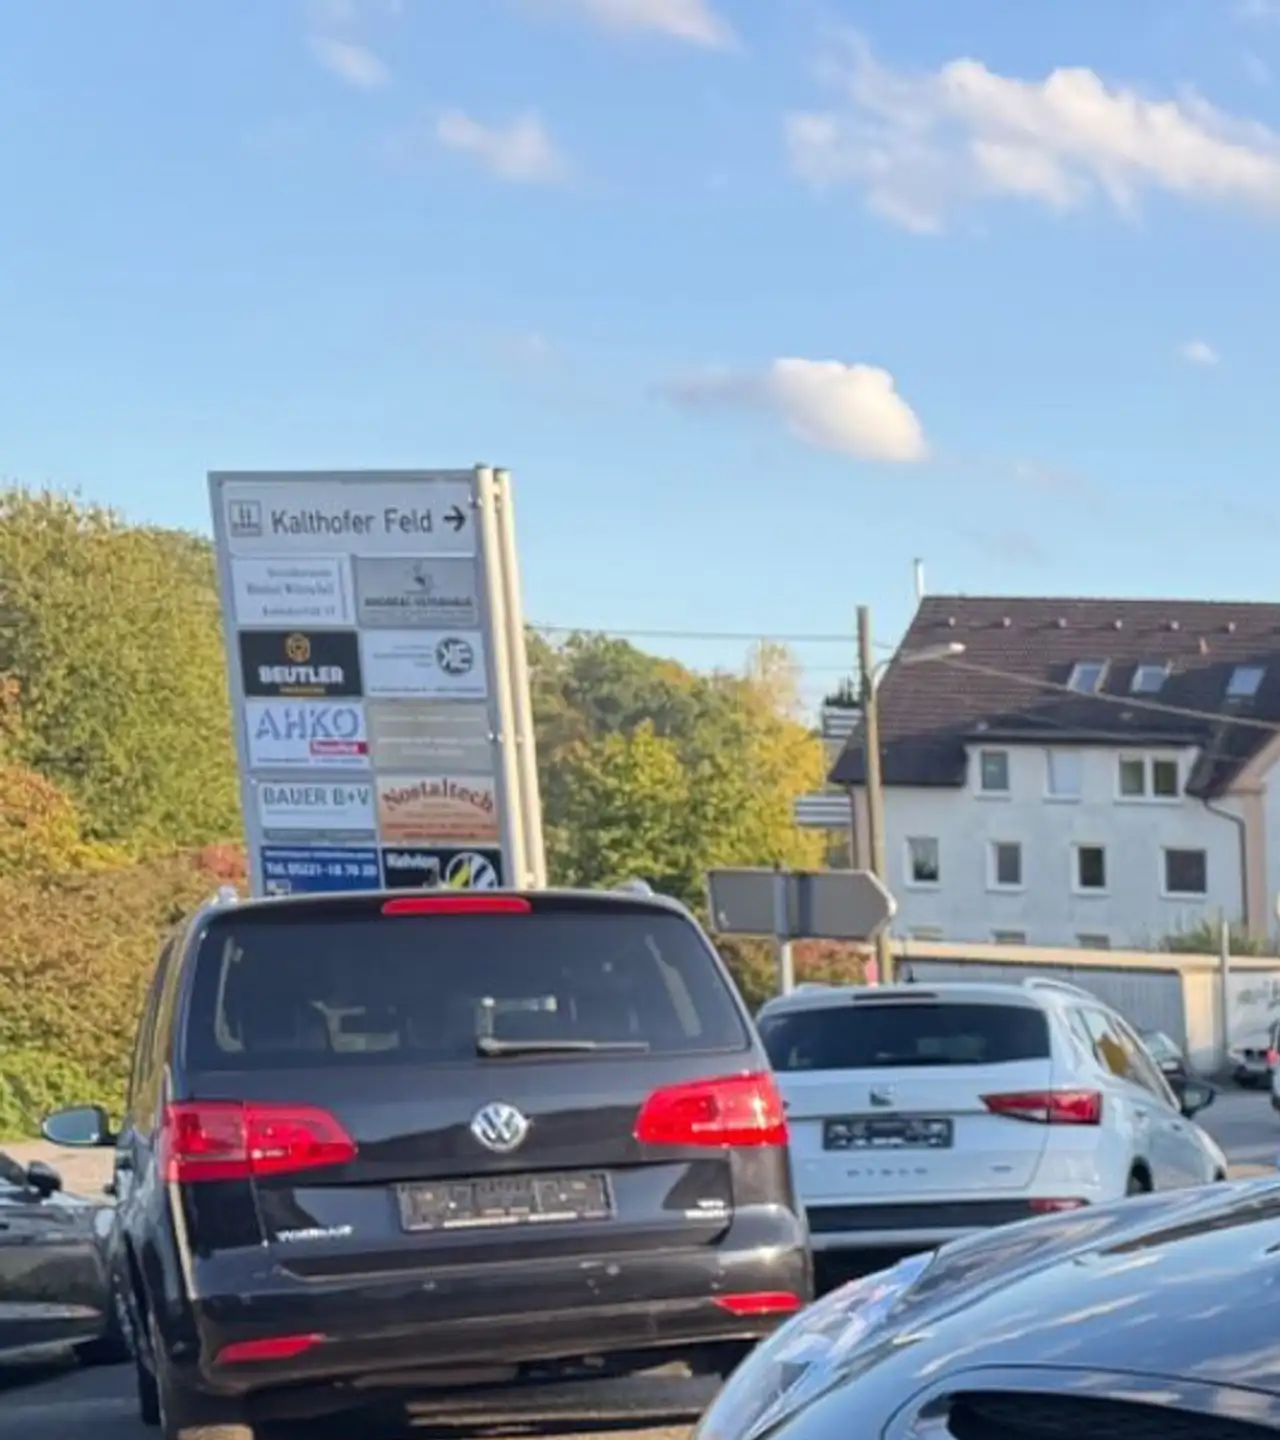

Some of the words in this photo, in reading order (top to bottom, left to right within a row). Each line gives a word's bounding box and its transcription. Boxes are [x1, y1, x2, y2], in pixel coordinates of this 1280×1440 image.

[271, 508, 376, 535] Kalthofer
[384, 507, 432, 534] Feld
[258, 665, 345, 685] BEUTLER
[255, 707, 359, 740] AHKO
[264, 787, 330, 806] BAUER
